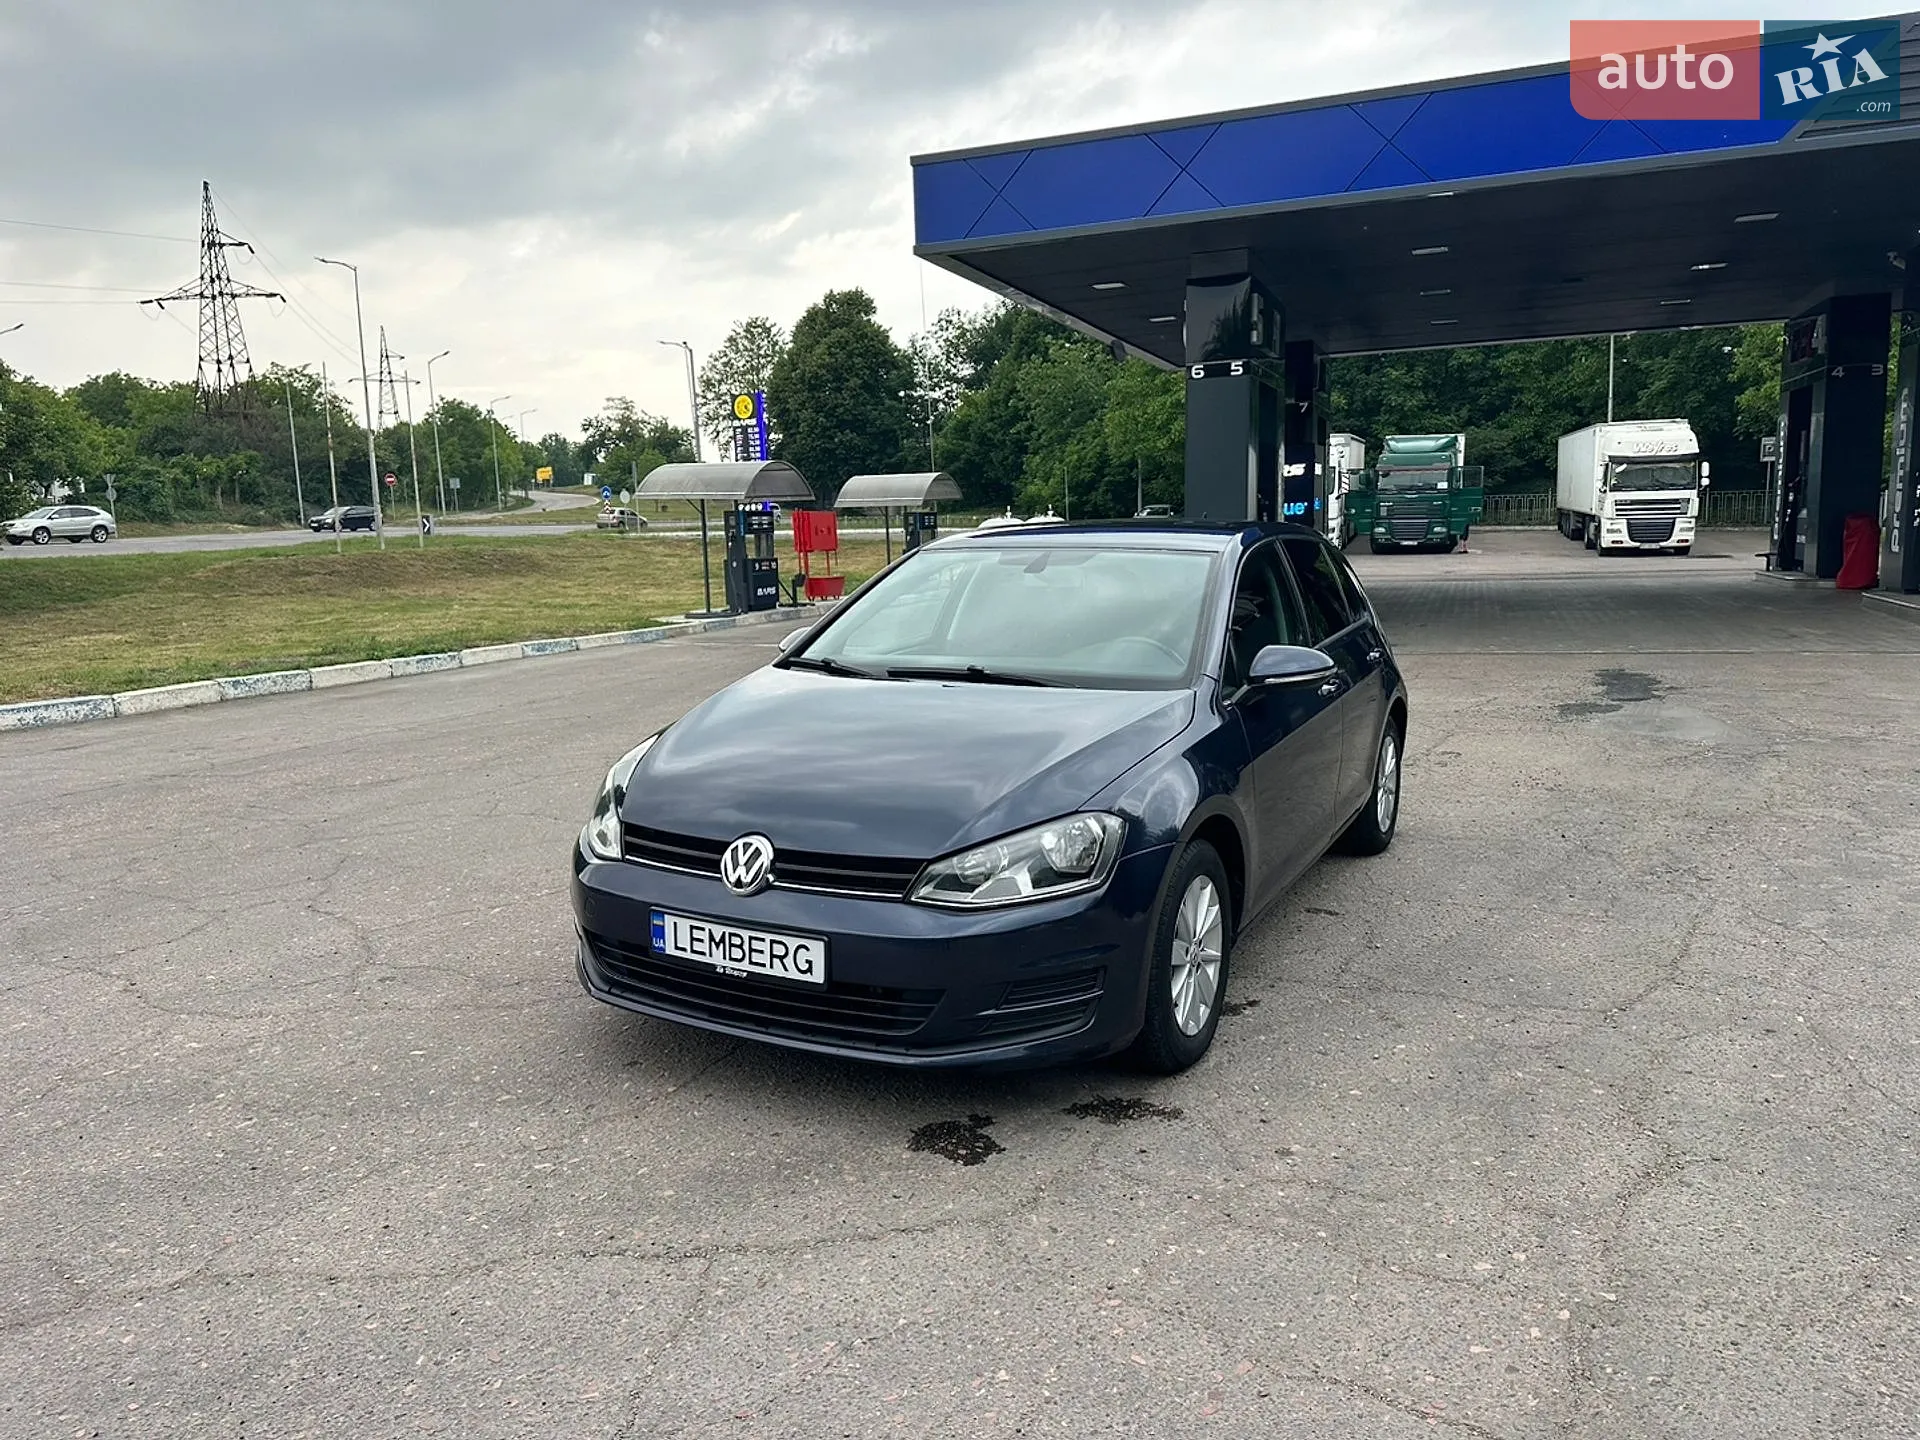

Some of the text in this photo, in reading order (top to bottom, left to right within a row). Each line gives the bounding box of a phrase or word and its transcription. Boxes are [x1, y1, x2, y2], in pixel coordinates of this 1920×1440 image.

[1191, 361, 1244, 379] 6 5
[1831, 364, 1884, 378] 4 3
[652, 938, 665, 948] UA
[672, 921, 814, 977] LEMBERG
